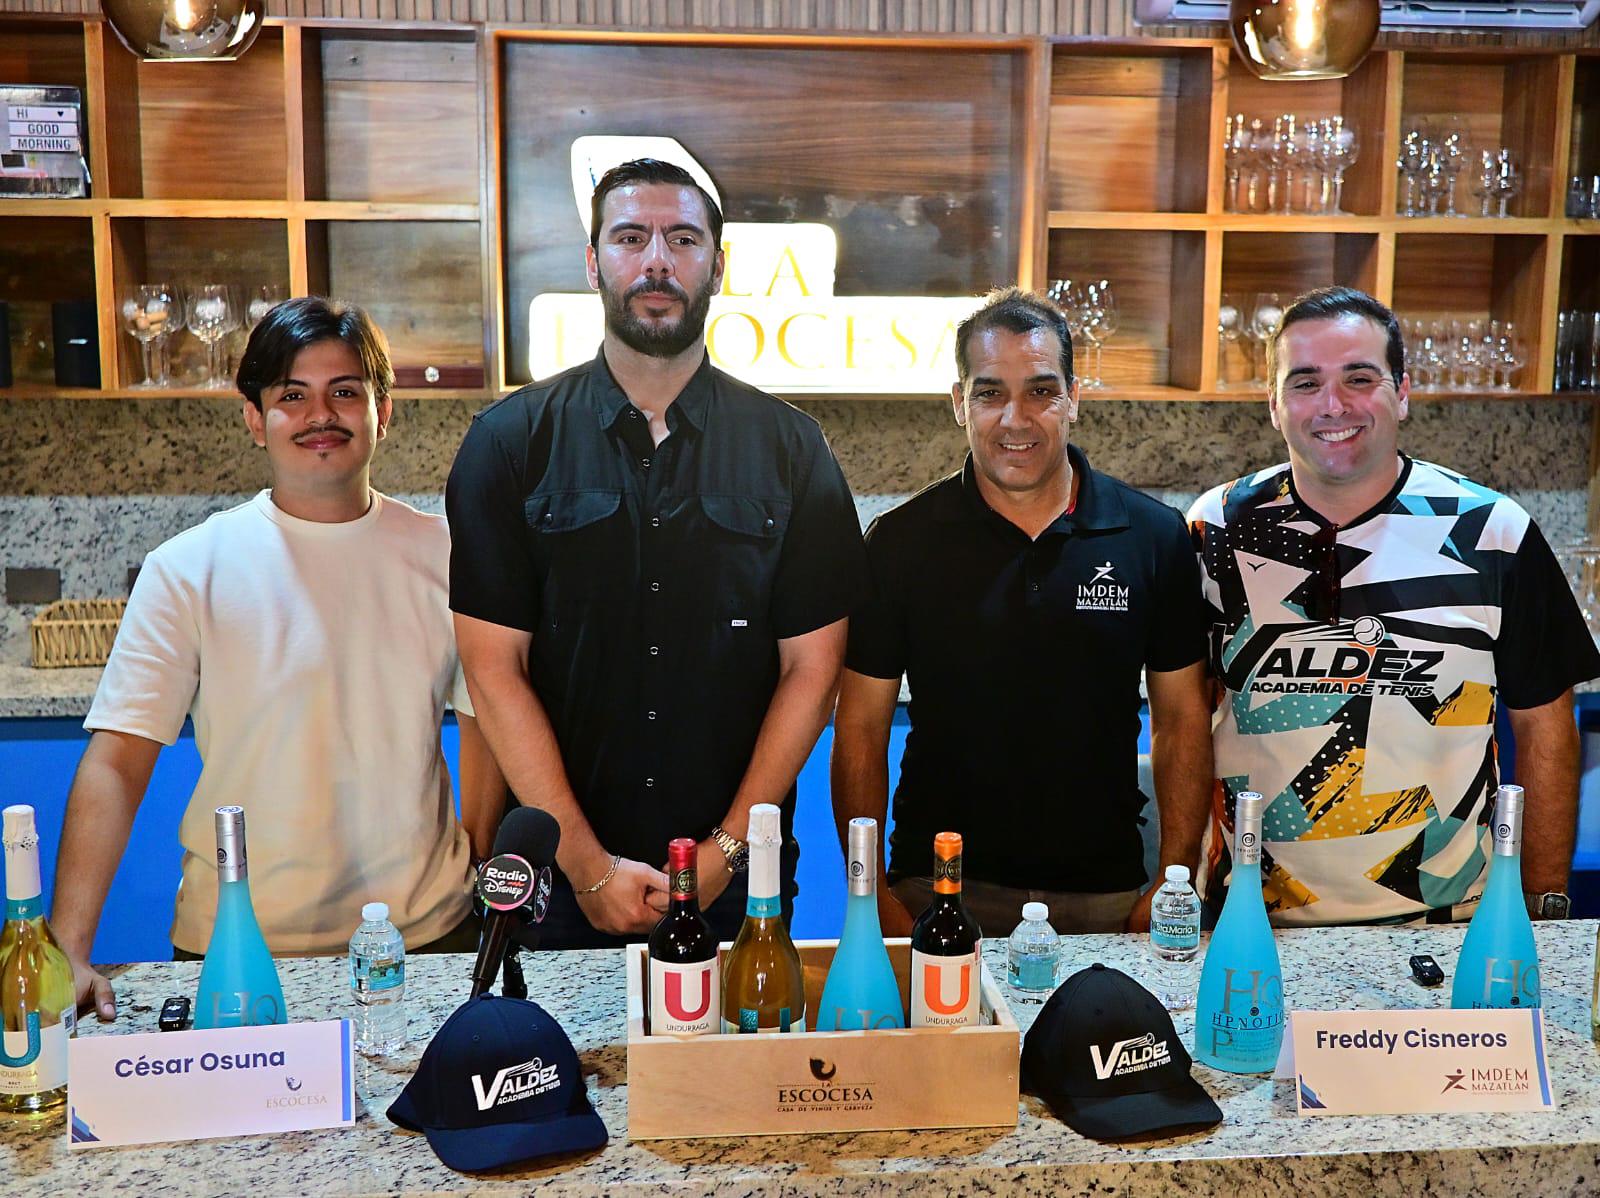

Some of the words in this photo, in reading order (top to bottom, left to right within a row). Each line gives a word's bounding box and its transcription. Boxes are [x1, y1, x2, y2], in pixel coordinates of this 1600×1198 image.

[17, 109, 28, 119] HI
[28, 124, 60, 135] GOOD
[18, 139, 71, 150] MORNING
[722, 241, 814, 296] LA
[1078, 584, 1129, 598] IMDEM
[1213, 622, 1445, 694] VALDEZ
[1249, 681, 1345, 695] ACADEMIA
[1349, 681, 1374, 696] DE
[1377, 684, 1435, 697] TENIS
[486, 868, 528, 882] Radio
[483, 877, 524, 900] Disney
[664, 968, 711, 1022] U
[924, 964, 971, 1016] U
[666, 1022, 710, 1033] UNDURRAGA
[925, 1015, 968, 1026] UNDURRAGA
[1316, 1029, 1398, 1054] Freddy
[1404, 1028, 1507, 1048] Cisneros
[115, 1055, 194, 1078] César
[200, 1050, 286, 1072] Osuna
[1090, 1040, 1169, 1080] VALDEZ
[1472, 1068, 1528, 1081] IMDEM
[471, 1063, 559, 1111] VALDEZ
[778, 1087, 873, 1103] ESCOCESA
[266, 1095, 328, 1109] ESCOCESA
